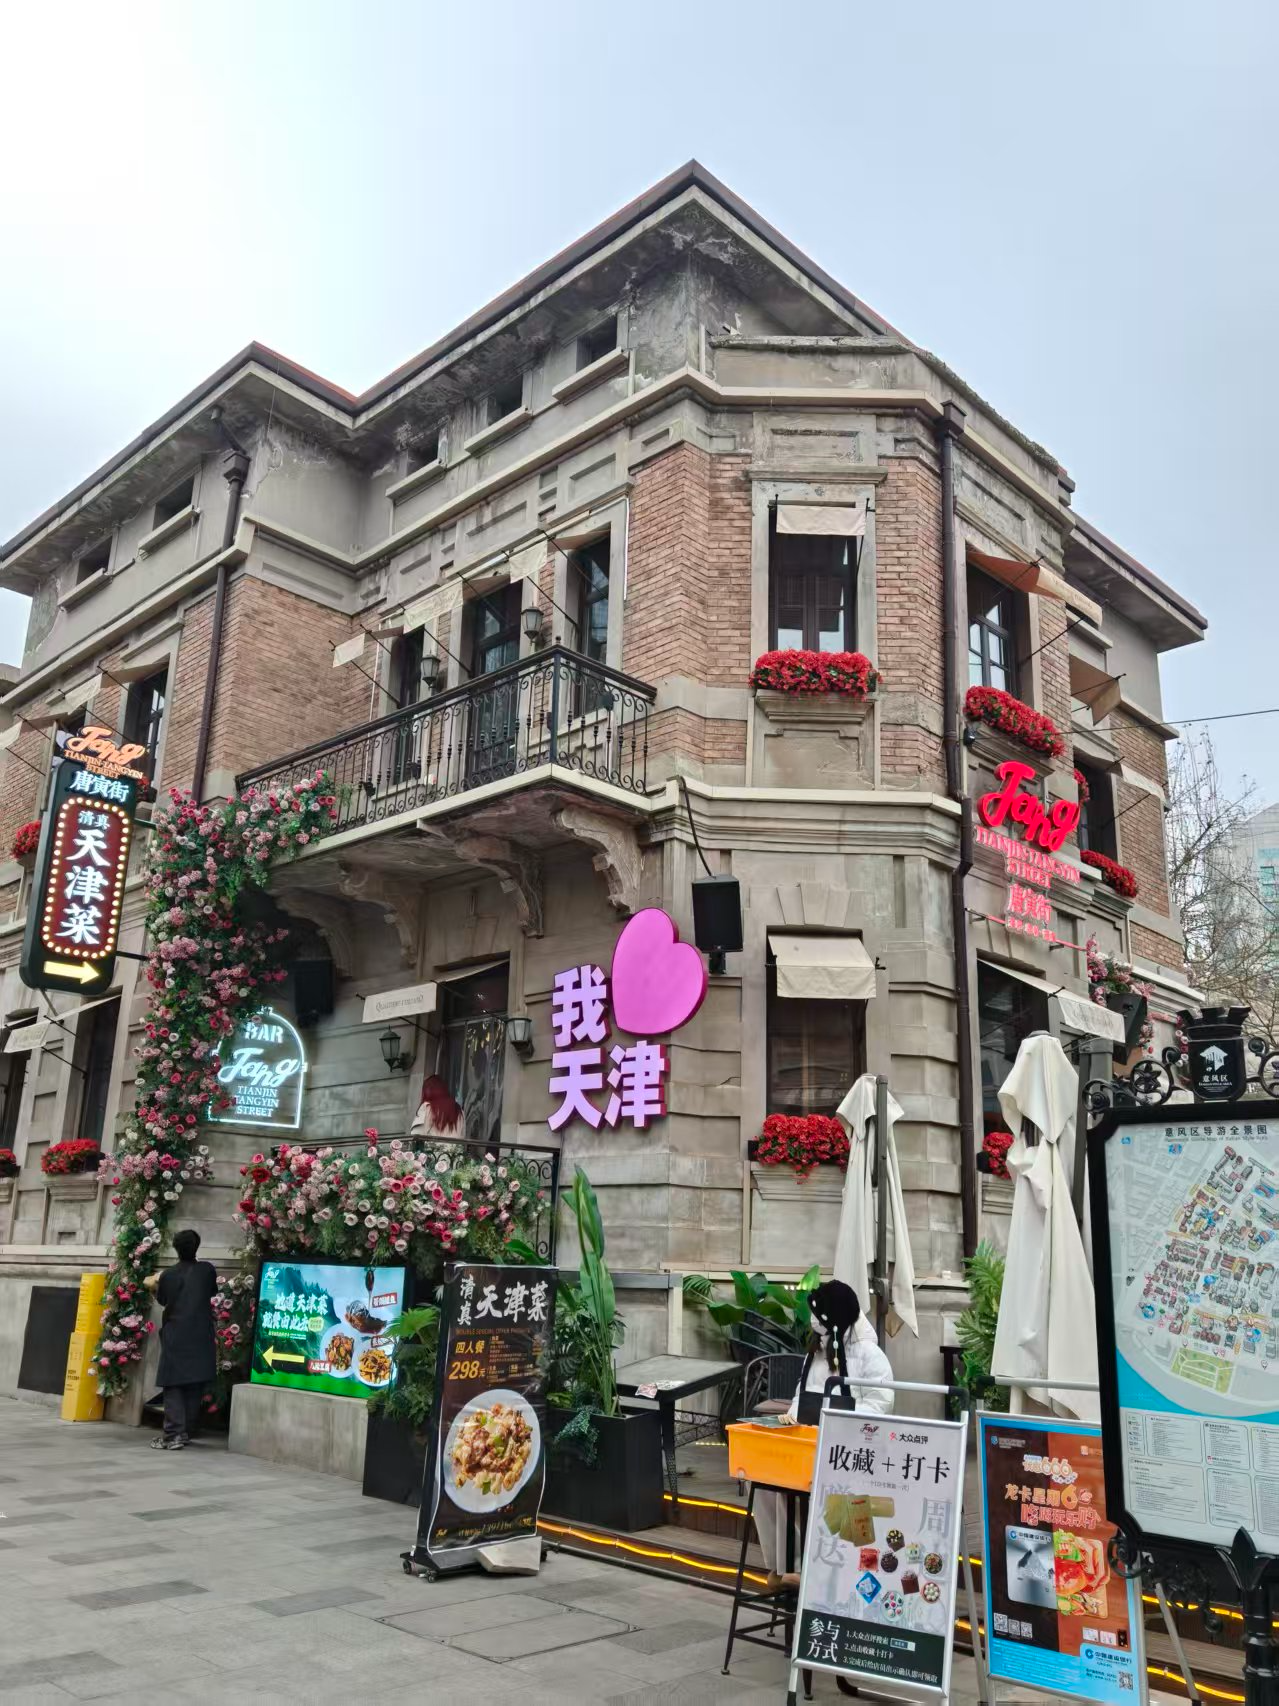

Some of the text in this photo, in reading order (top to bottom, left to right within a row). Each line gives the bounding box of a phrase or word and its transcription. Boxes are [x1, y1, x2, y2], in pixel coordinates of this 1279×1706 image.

[66, 726, 146, 766] Tang
[69, 770, 129, 802] 唐寅街
[77, 810, 110, 830] 清真
[976, 760, 1081, 852] Tang
[55, 828, 111, 945] 天津菜
[1006, 858, 1052, 890] STREET
[1007, 883, 1053, 925] 唐寅街
[551, 964, 611, 1048] 我
[245, 1021, 284, 1044] BAR
[217, 1047, 299, 1087] Tang
[235, 1095, 280, 1108] TANGYIN
[237, 1085, 278, 1098] TIANJIN
[547, 1040, 670, 1131] 天津
[236, 1105, 274, 1117] STREET
[1165, 1125, 1267, 1137] 意风区导游全景图
[457, 1274, 476, 1326] 清真
[474, 1281, 549, 1323] 天津菜
[455, 1340, 485, 1354] 四人餐
[899, 1433, 929, 1445] 大众点评
[808, 1617, 841, 1641] 参与
[806, 1640, 838, 1663] 方式
